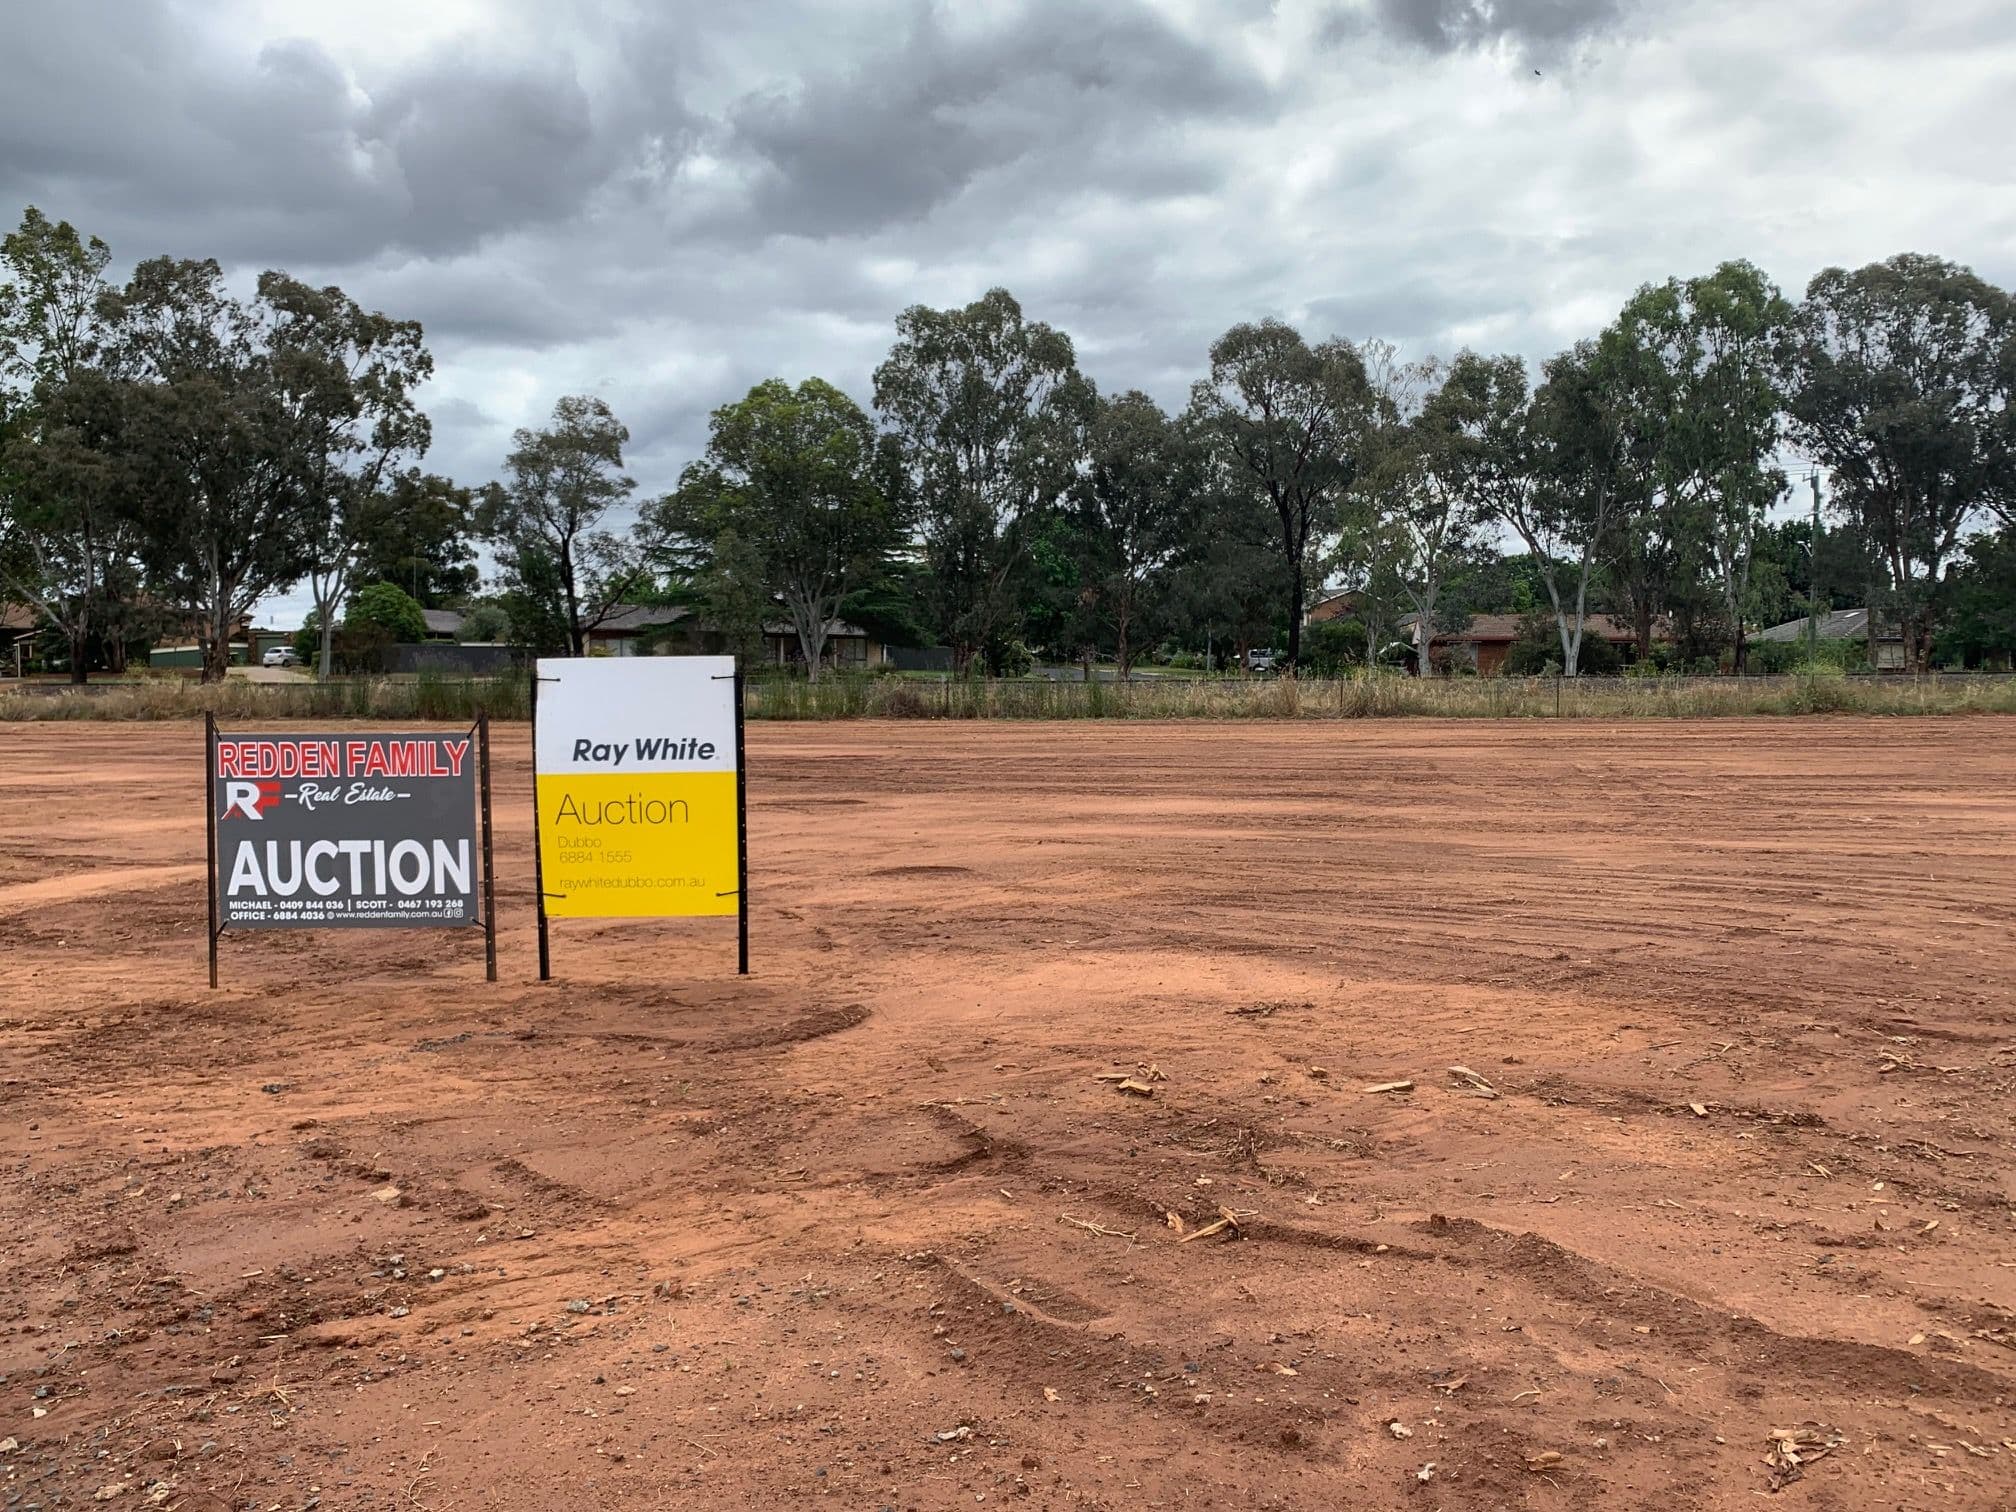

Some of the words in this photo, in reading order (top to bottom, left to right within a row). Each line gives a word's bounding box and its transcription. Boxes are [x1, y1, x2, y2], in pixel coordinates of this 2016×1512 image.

[573, 738, 629, 766] Ray
[635, 737, 716, 762] White
[218, 741, 341, 778] REDDEN
[347, 740, 469, 777] FAMILY
[299, 782, 341, 811] Real
[344, 781, 397, 805] Estate
[555, 792, 689, 825] Auction
[557, 835, 602, 849] Dubbo
[559, 850, 593, 864] 6884
[600, 850, 633, 863] 1555
[227, 839, 470, 896] AUCTION
[559, 876, 706, 891] raywhitedubbo.com.au
[229, 900, 273, 910] MICHAEL
[279, 900, 304, 910] 0409
[305, 900, 324, 909] 844
[325, 900, 344, 909] 036
[355, 900, 388, 909] SCOTT
[397, 900, 422, 909] 0467
[424, 899, 443, 908] 193
[445, 899, 464, 908] 268
[230, 911, 266, 920] OFFICE
[273, 911, 298, 920] 6884
[300, 911, 326, 920] 4036
[335, 909, 443, 919] www.reddenfamily.com.au
